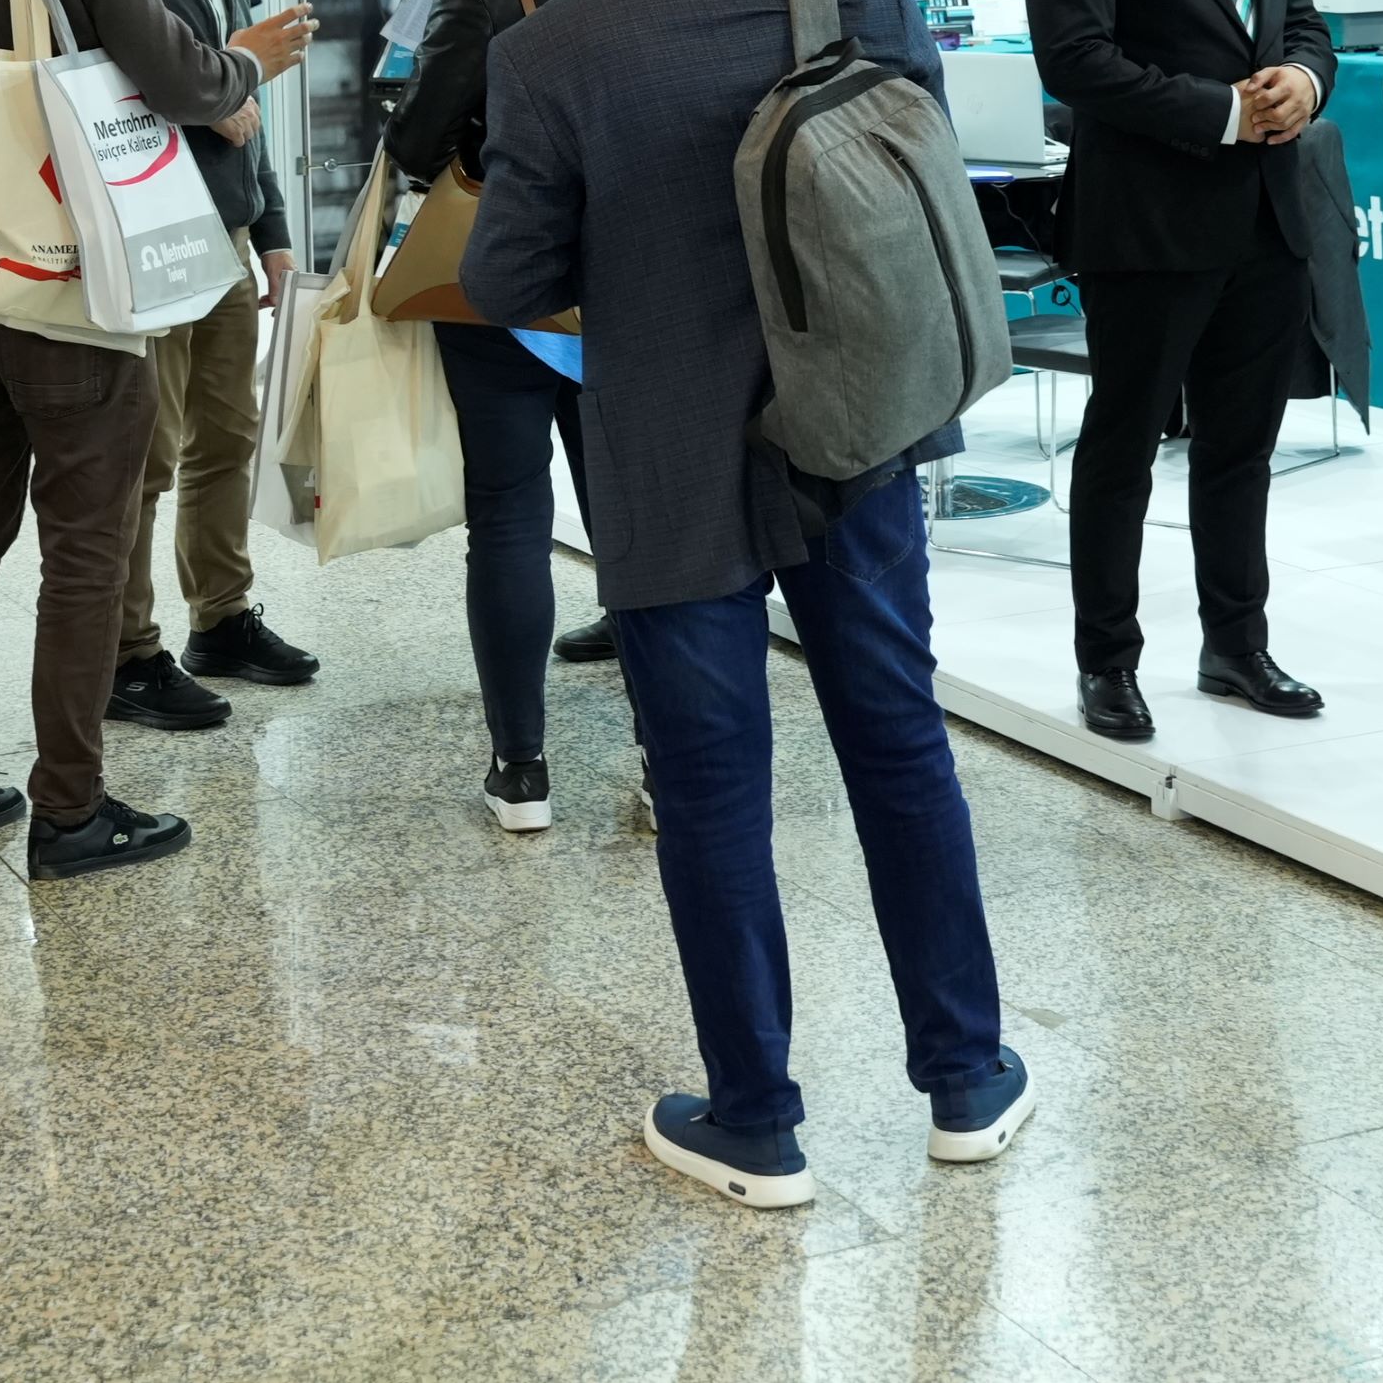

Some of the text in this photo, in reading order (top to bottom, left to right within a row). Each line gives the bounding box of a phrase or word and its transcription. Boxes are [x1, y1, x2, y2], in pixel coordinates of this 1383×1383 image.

[93, 111, 157, 141] Metrohm
[127, 130, 162, 153] Kalitesi
[159, 234, 209, 265] Metrohm
